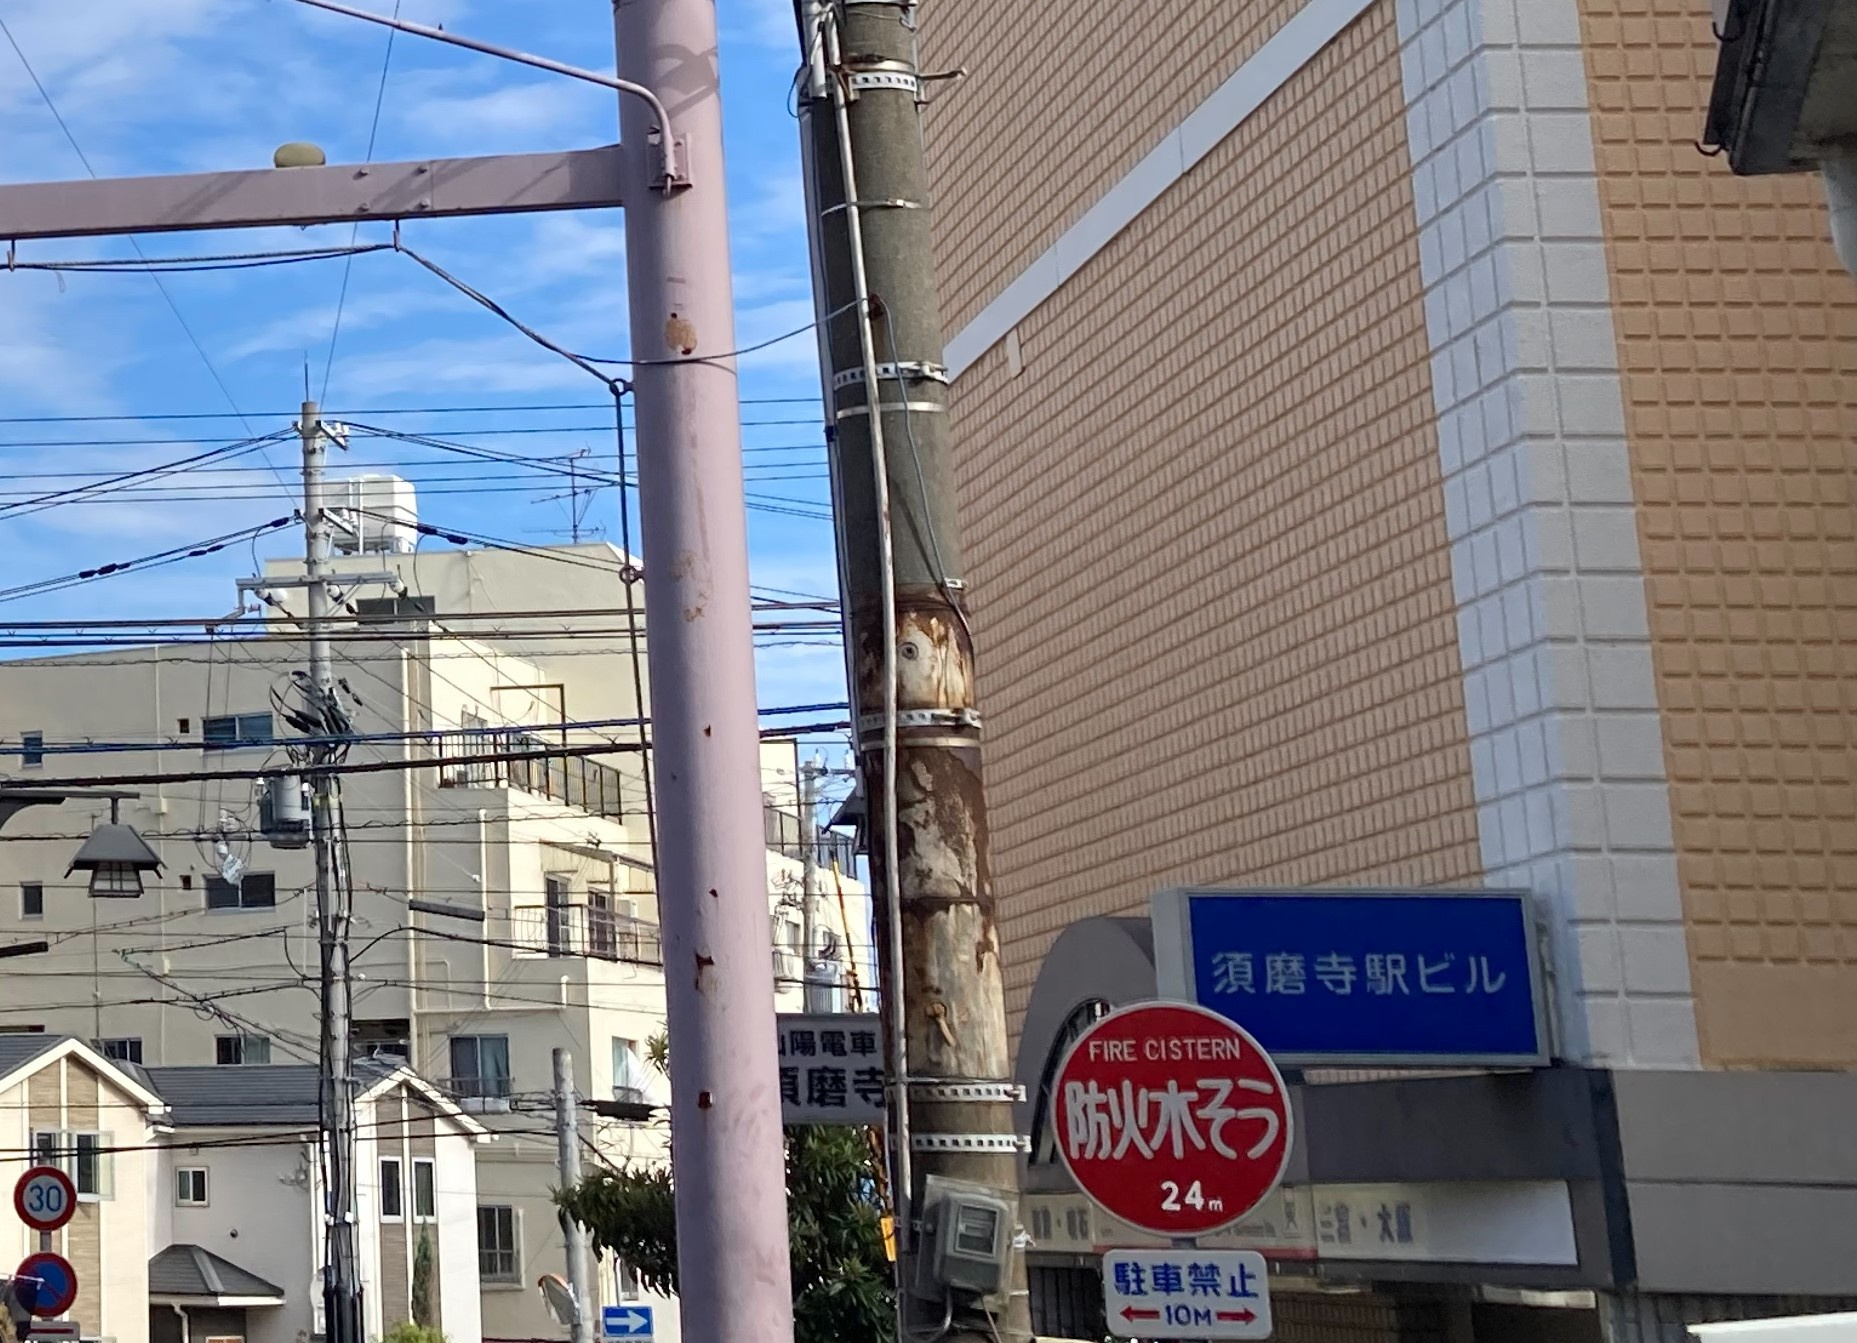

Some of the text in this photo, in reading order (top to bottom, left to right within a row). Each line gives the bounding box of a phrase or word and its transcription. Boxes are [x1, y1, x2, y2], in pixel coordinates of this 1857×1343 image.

[1210, 950, 1506, 996] 須磨寺駅ビル
[1089, 1038, 1240, 1063] FIRE CISTERN
[28, 1185, 62, 1212] 30
[1114, 1262, 1259, 1298] 駐車禁止
[1165, 1306, 1212, 1325] 10M
